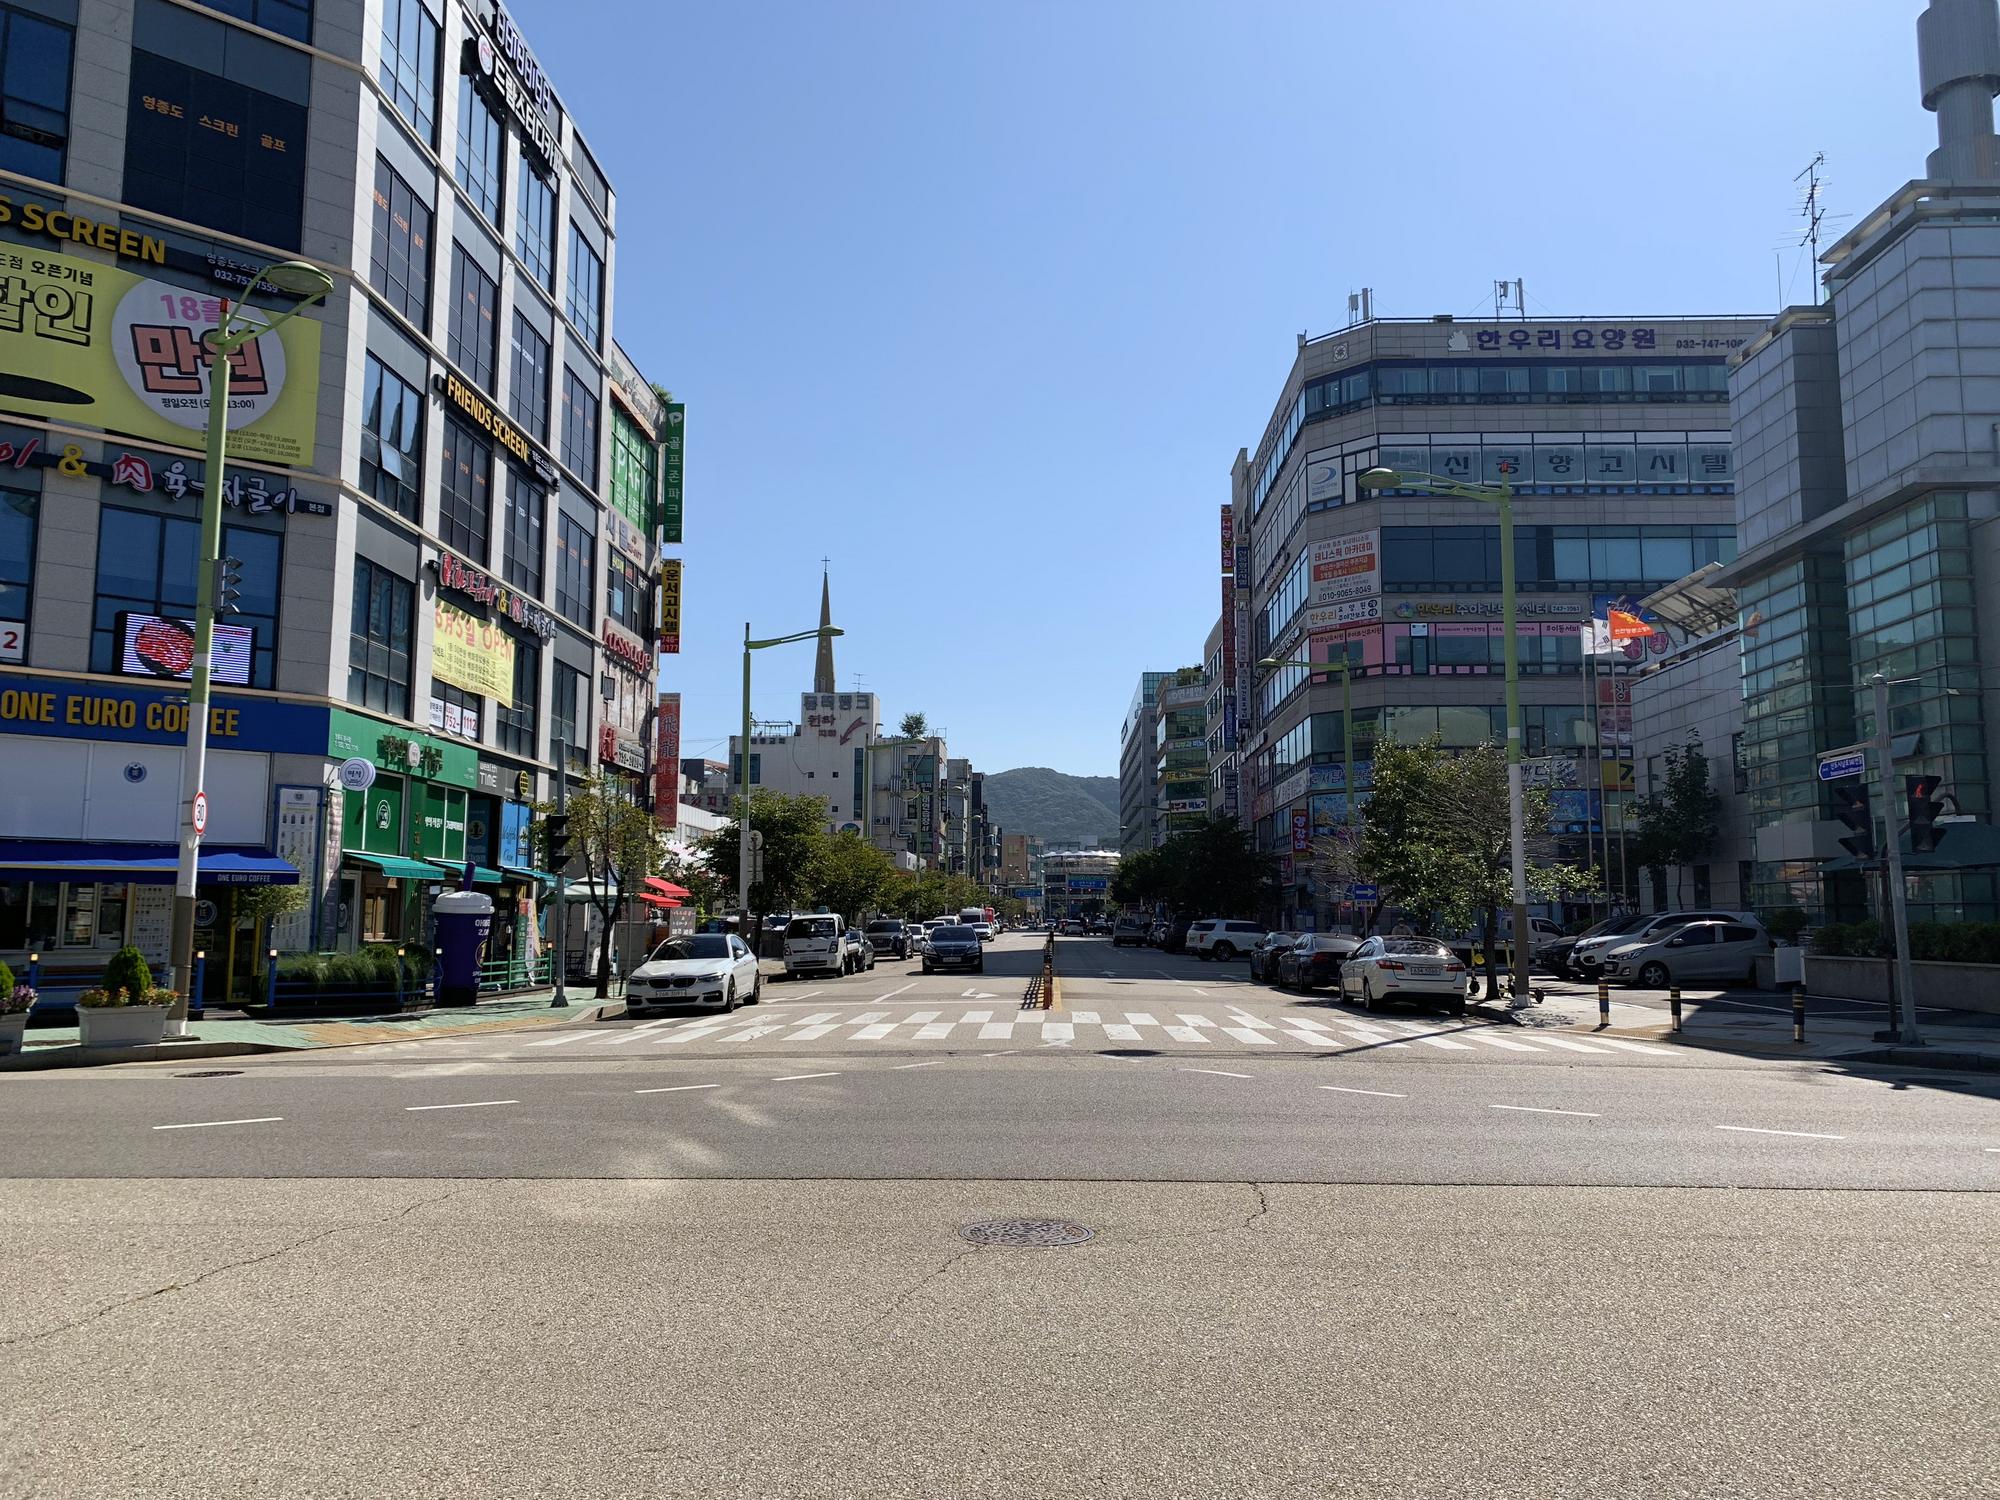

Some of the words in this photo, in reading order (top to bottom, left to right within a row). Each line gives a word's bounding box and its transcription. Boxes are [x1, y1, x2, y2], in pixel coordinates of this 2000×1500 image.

[143, 95, 183, 118] 영종도
[198, 114, 239, 138] 스크린
[260, 134, 286, 152] 골프
[21, 203, 165, 264] SCREEN
[30, 259, 93, 286] 오픈기념
[1476, 329, 1560, 351] 한우리
[1572, 329, 1656, 351] 요양원
[448, 374, 492, 431] FRIENDS
[493, 416, 529, 463] SCREEN
[668, 436, 680, 515] 골프존파크
[1445, 454, 1727, 476] 신공항고시텔
[1344, 541, 1373, 555] 아카데미
[664, 569, 679, 633] 운서고시텔
[1322, 585, 1372, 601] 010-9065-8049
[1310, 609, 1337, 625] 한우리
[1, 689, 57, 723] ONE
[66, 695, 136, 729] EURO
[146, 702, 240, 737] COFEE
[464, 716, 477, 732] 1112
[196, 804, 204, 821] 30
[218, 874, 229, 882] ONE
[231, 874, 247, 883] EURO
[249, 875, 271, 883] COFFEE
